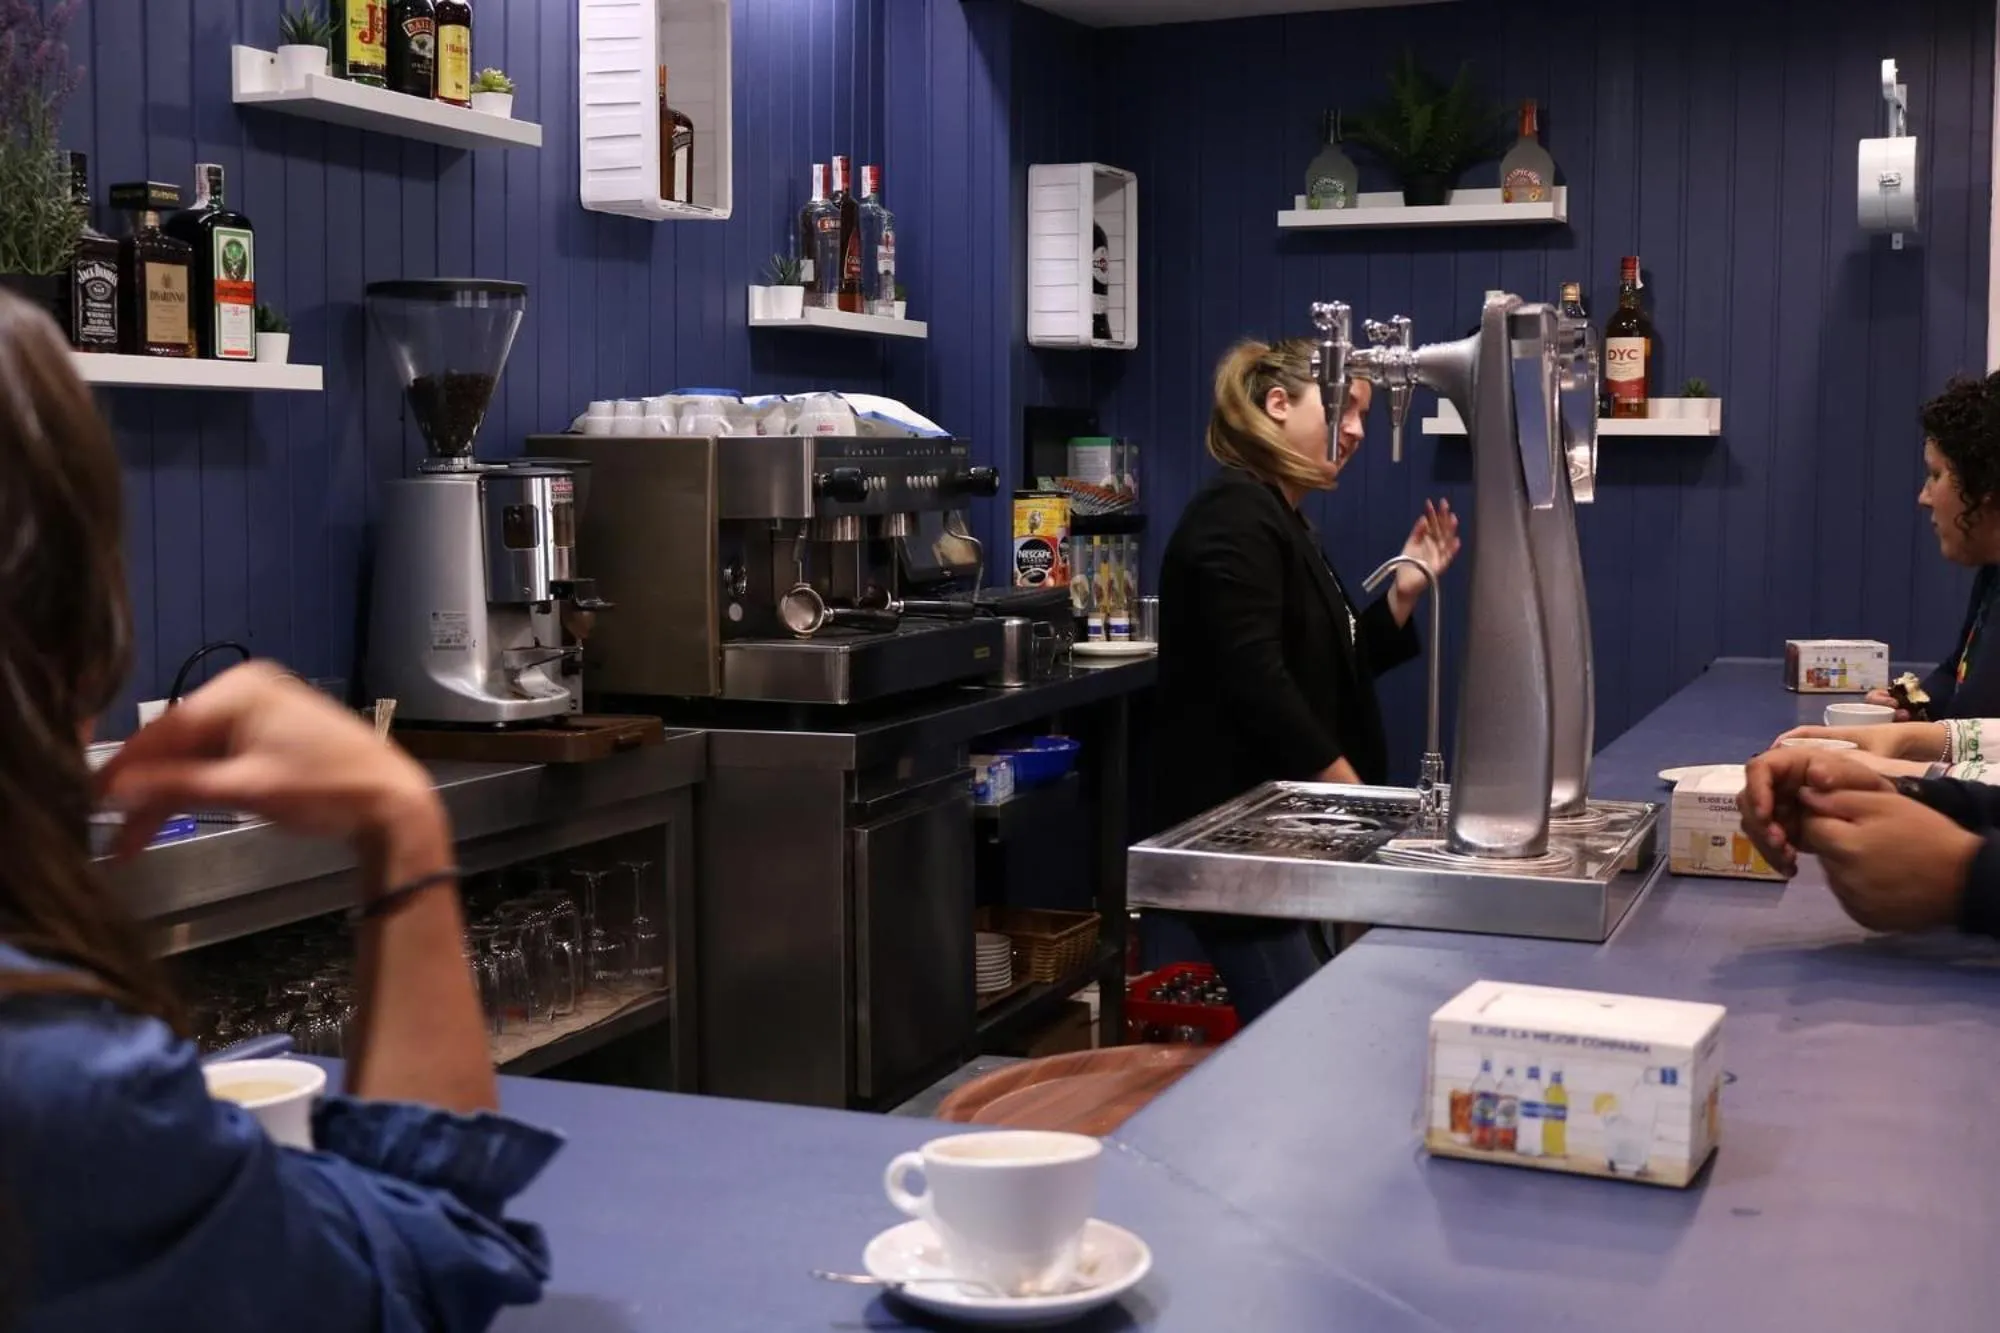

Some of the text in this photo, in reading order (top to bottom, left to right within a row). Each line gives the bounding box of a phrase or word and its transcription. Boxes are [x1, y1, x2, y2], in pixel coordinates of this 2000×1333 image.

[1608, 348, 1640, 361] DYC
[1470, 1026, 1508, 1039] ELIGE
[1512, 1029, 1530, 1041] LA
[1533, 1031, 1580, 1047] MEJOR
